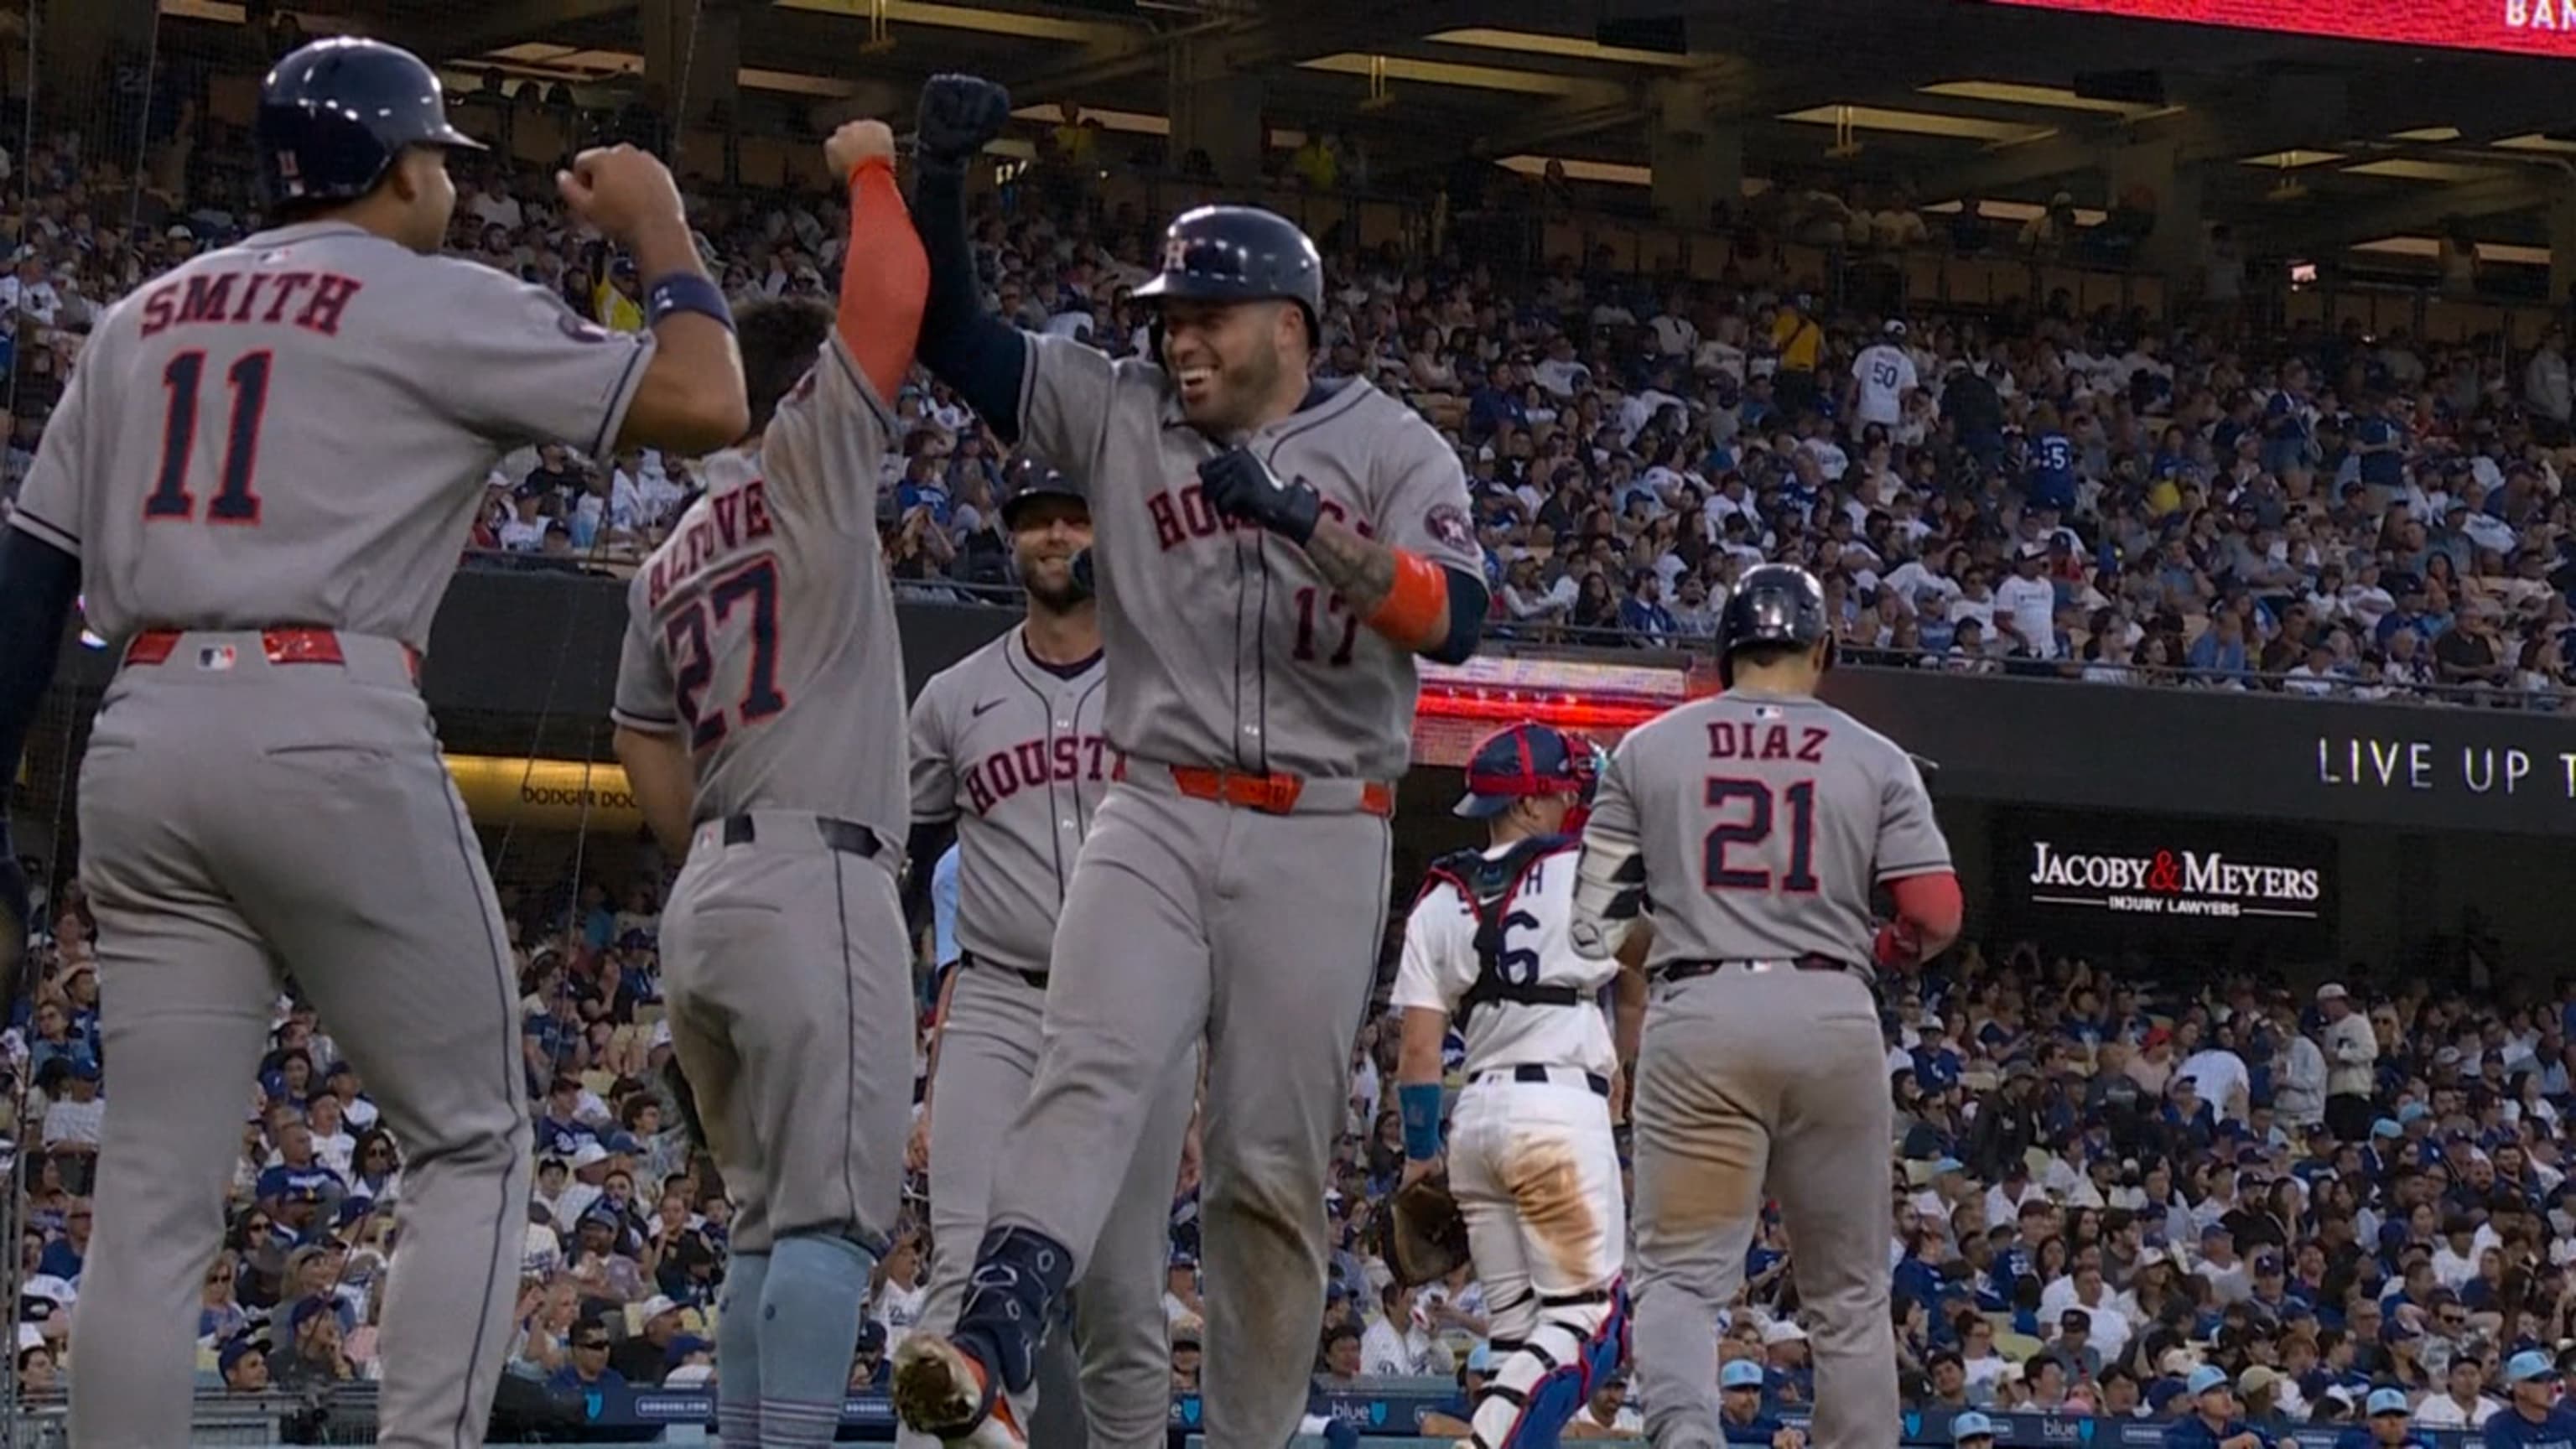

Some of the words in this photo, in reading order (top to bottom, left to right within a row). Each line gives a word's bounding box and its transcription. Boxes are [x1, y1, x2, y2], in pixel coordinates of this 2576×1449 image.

[140, 271, 363, 339] SMITH
[1872, 361, 1898, 388] 50
[142, 345, 276, 526] 11
[664, 550, 787, 756] 27
[1292, 586, 1358, 667] 17
[1706, 722, 1830, 764] DIAZ
[2319, 738, 2431, 787] LIVE
[2463, 747, 2529, 793] UP
[1704, 775, 1820, 892] 21
[2108, 895, 2164, 912] INJURY
[2168, 899, 2240, 917] LAWYERS
[1497, 909, 1540, 986] 6
[1331, 1400, 1369, 1420] blue
[2043, 1417, 2079, 1437] blue
